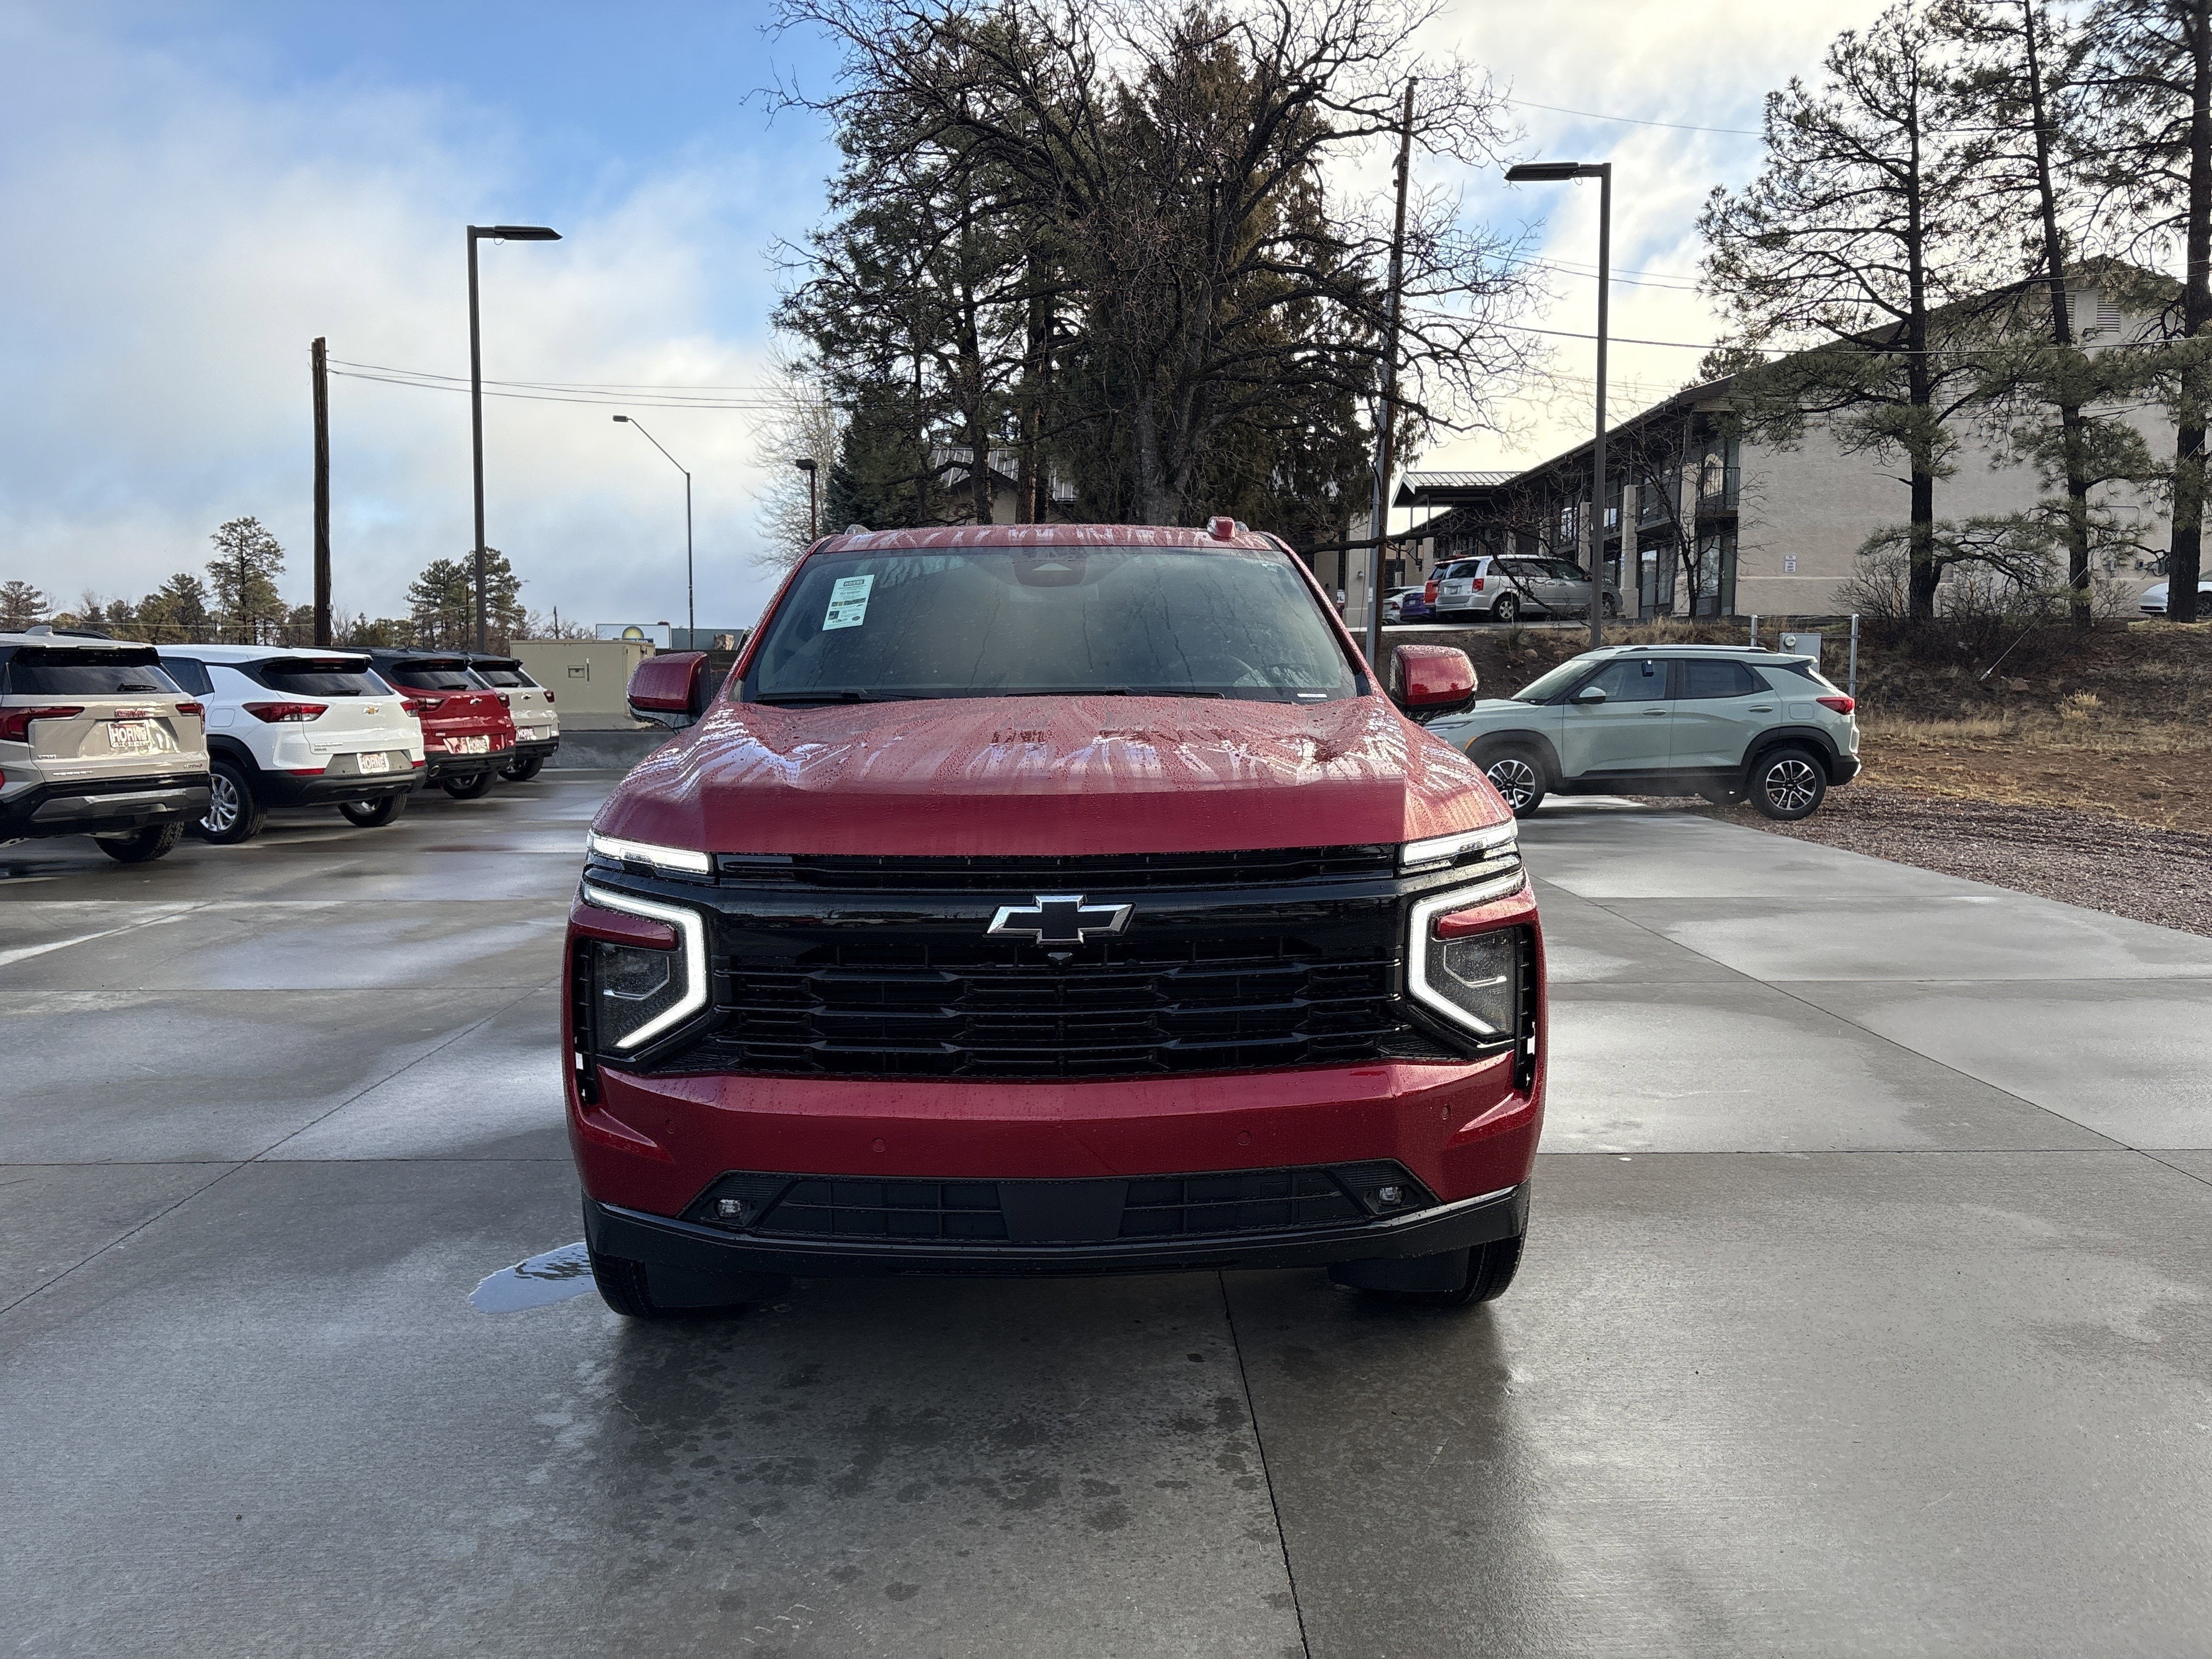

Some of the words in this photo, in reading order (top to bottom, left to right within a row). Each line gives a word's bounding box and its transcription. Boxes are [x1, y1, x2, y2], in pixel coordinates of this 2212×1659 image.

[115, 708, 154, 718] GMC
[469, 739, 487, 749] HORNE
[360, 757, 386, 769] HORNE
